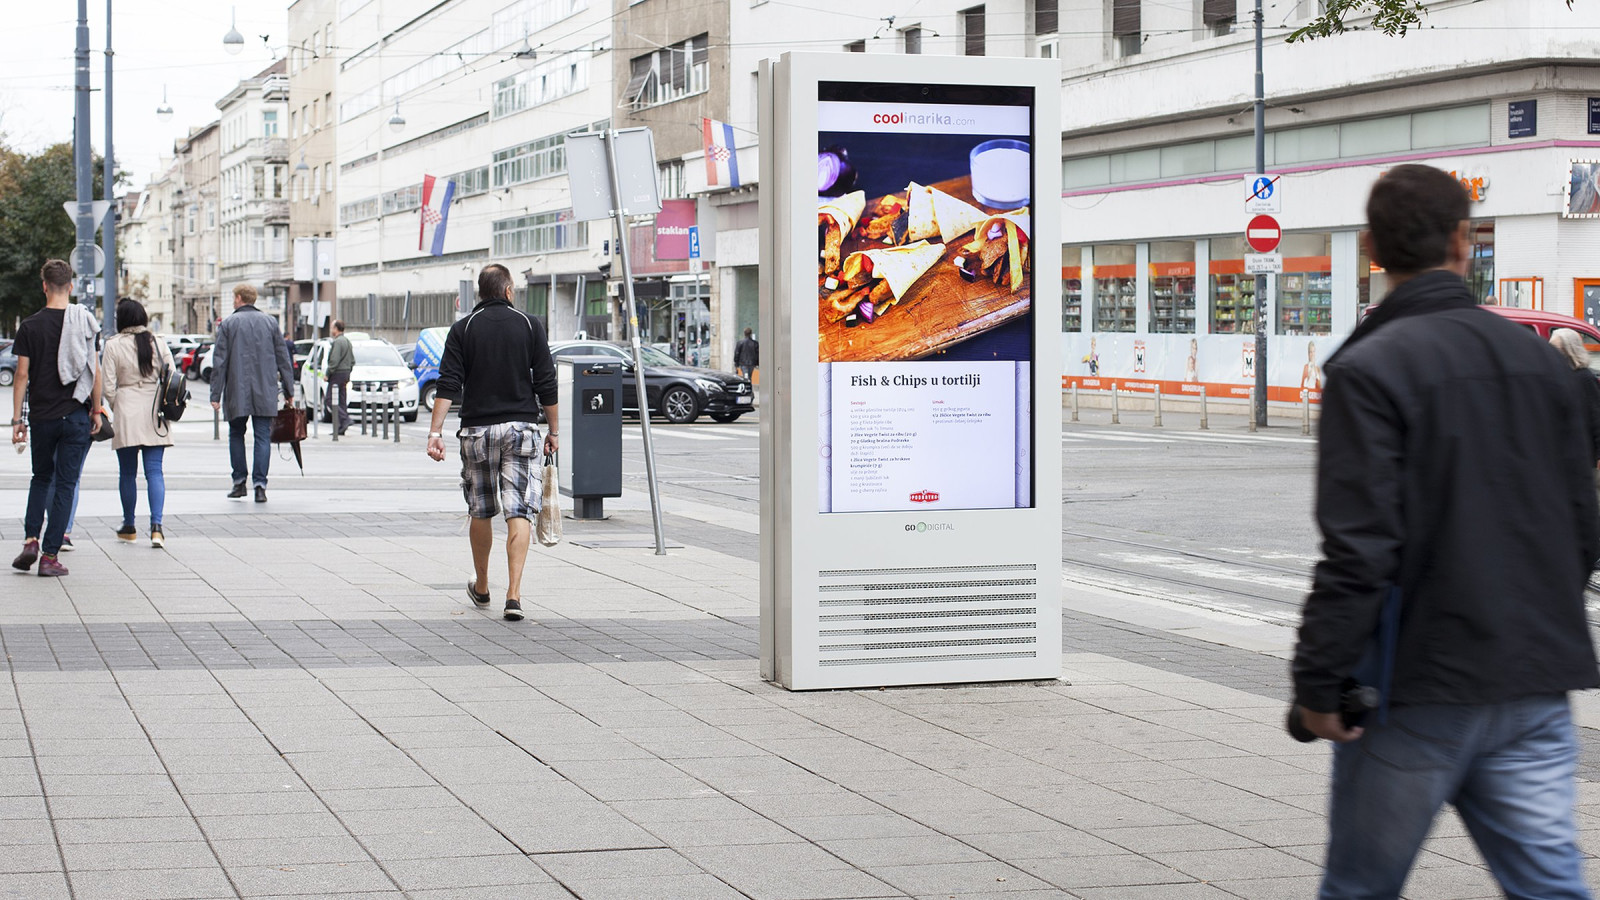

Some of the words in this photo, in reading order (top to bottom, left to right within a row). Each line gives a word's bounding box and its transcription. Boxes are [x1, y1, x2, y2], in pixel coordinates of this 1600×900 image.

[873, 112, 976, 126] coolinarika.com
[851, 374, 877, 386] Fish
[880, 375, 890, 386] &
[893, 374, 928, 388] Chips
[931, 376, 938, 386] u
[942, 374, 981, 388] tortilji
[927, 523, 955, 531] DIGITAL
